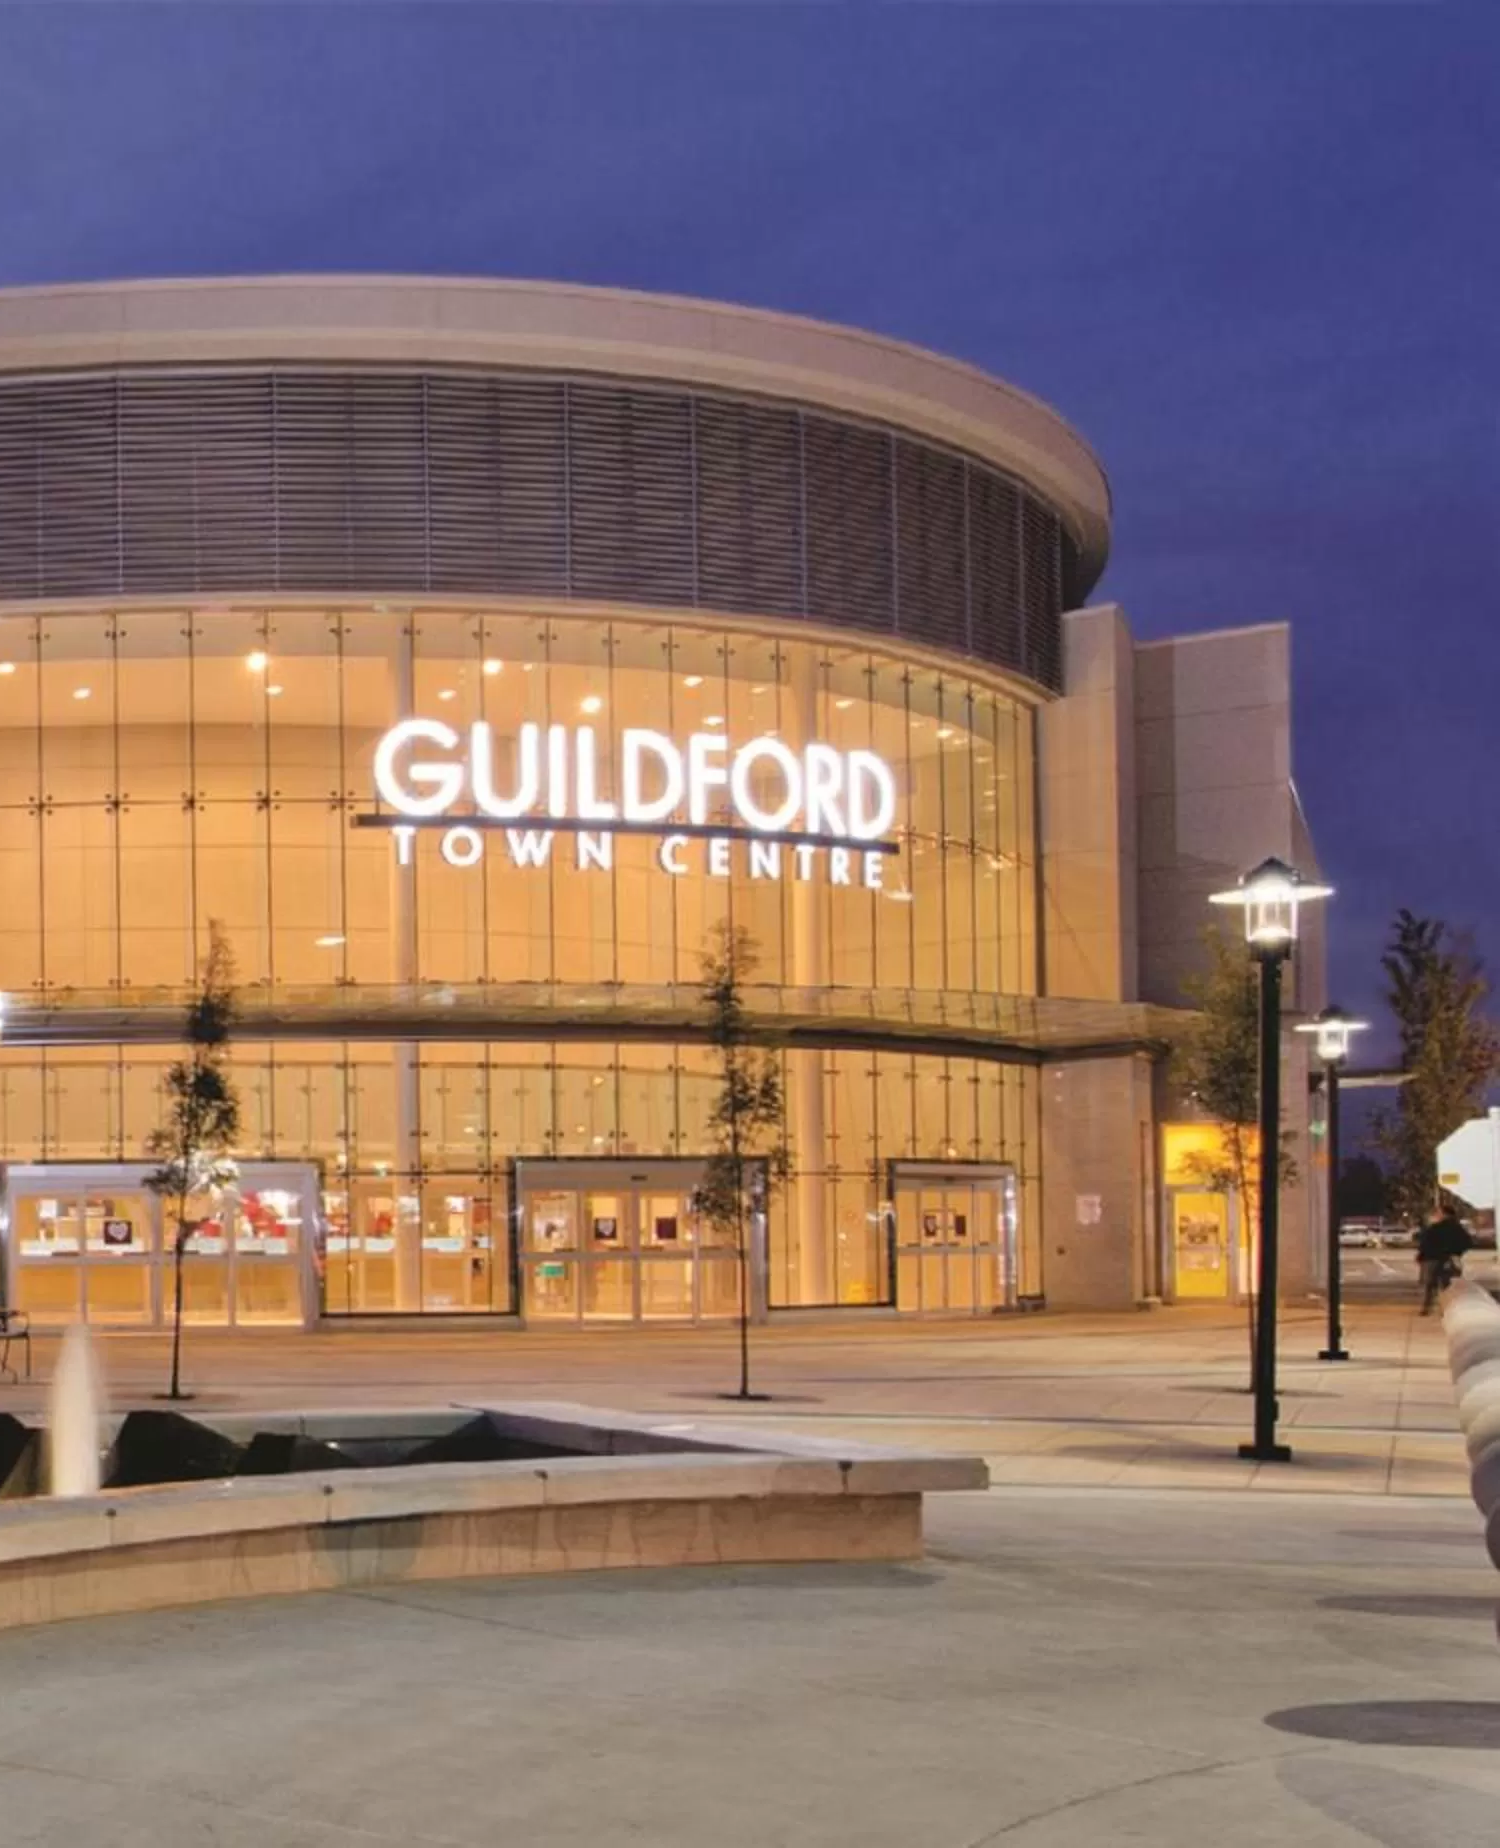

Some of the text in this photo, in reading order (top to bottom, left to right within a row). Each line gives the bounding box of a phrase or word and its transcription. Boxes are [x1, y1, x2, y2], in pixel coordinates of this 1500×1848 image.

[373, 718, 896, 841] GUILDFORD
[392, 825, 884, 889] TOWN CENTRE
